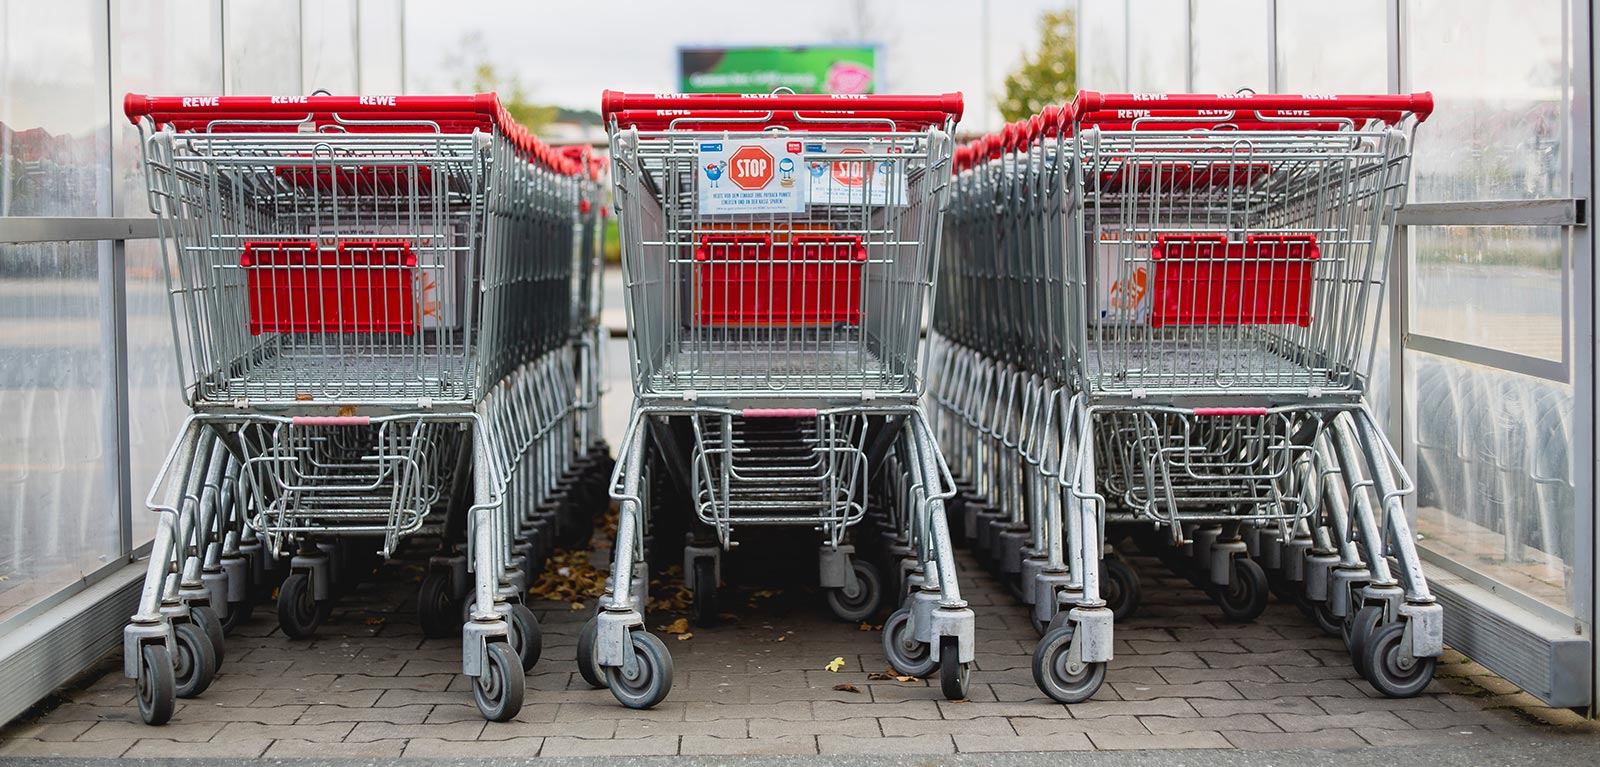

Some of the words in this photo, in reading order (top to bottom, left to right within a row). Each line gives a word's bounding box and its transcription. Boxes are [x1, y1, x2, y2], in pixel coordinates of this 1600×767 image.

[182, 97, 220, 107] REWE
[271, 96, 308, 104] REWE
[359, 96, 397, 106] REWE
[1117, 109, 1151, 118] REWE
[737, 159, 767, 177] STOP
[839, 161, 864, 177] STO
